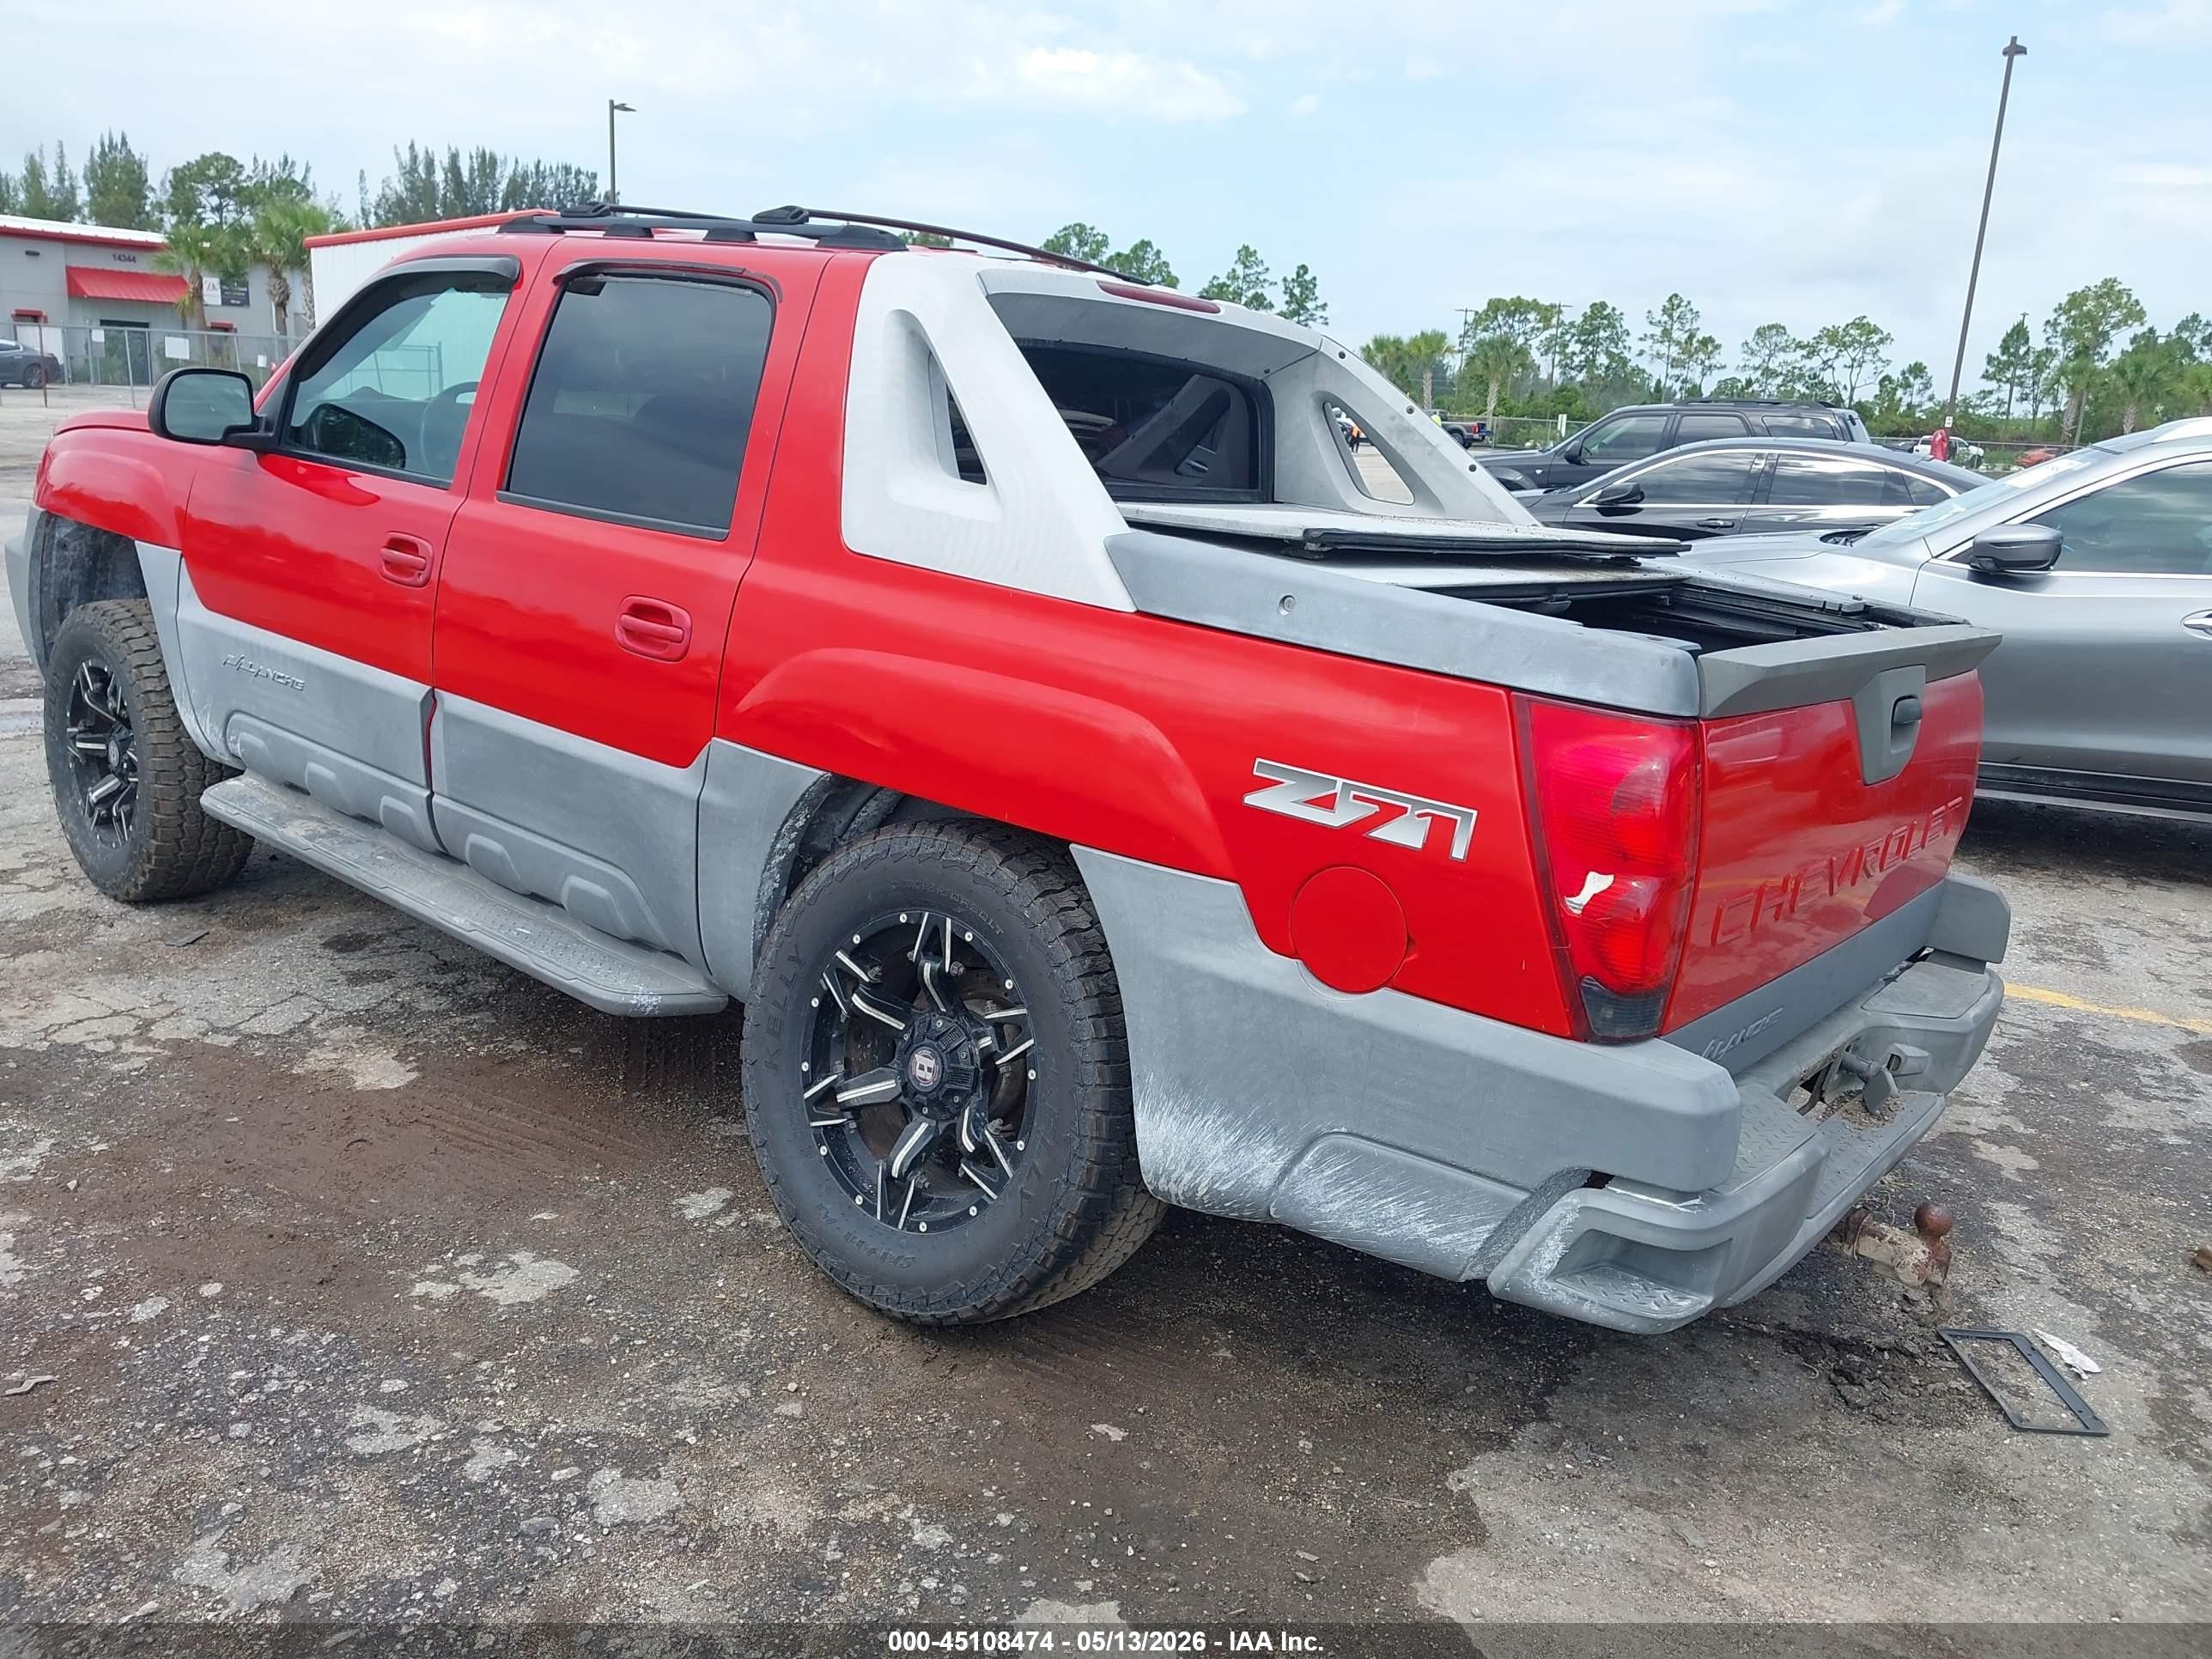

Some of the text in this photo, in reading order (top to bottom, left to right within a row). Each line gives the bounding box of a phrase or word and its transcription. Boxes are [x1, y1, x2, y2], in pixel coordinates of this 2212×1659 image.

[112, 253, 137, 264] 14344
[1243, 757, 1478, 862] Z71
[1710, 796, 1963, 948] CHEVROLET
[763, 940, 804, 1073] KELLY
